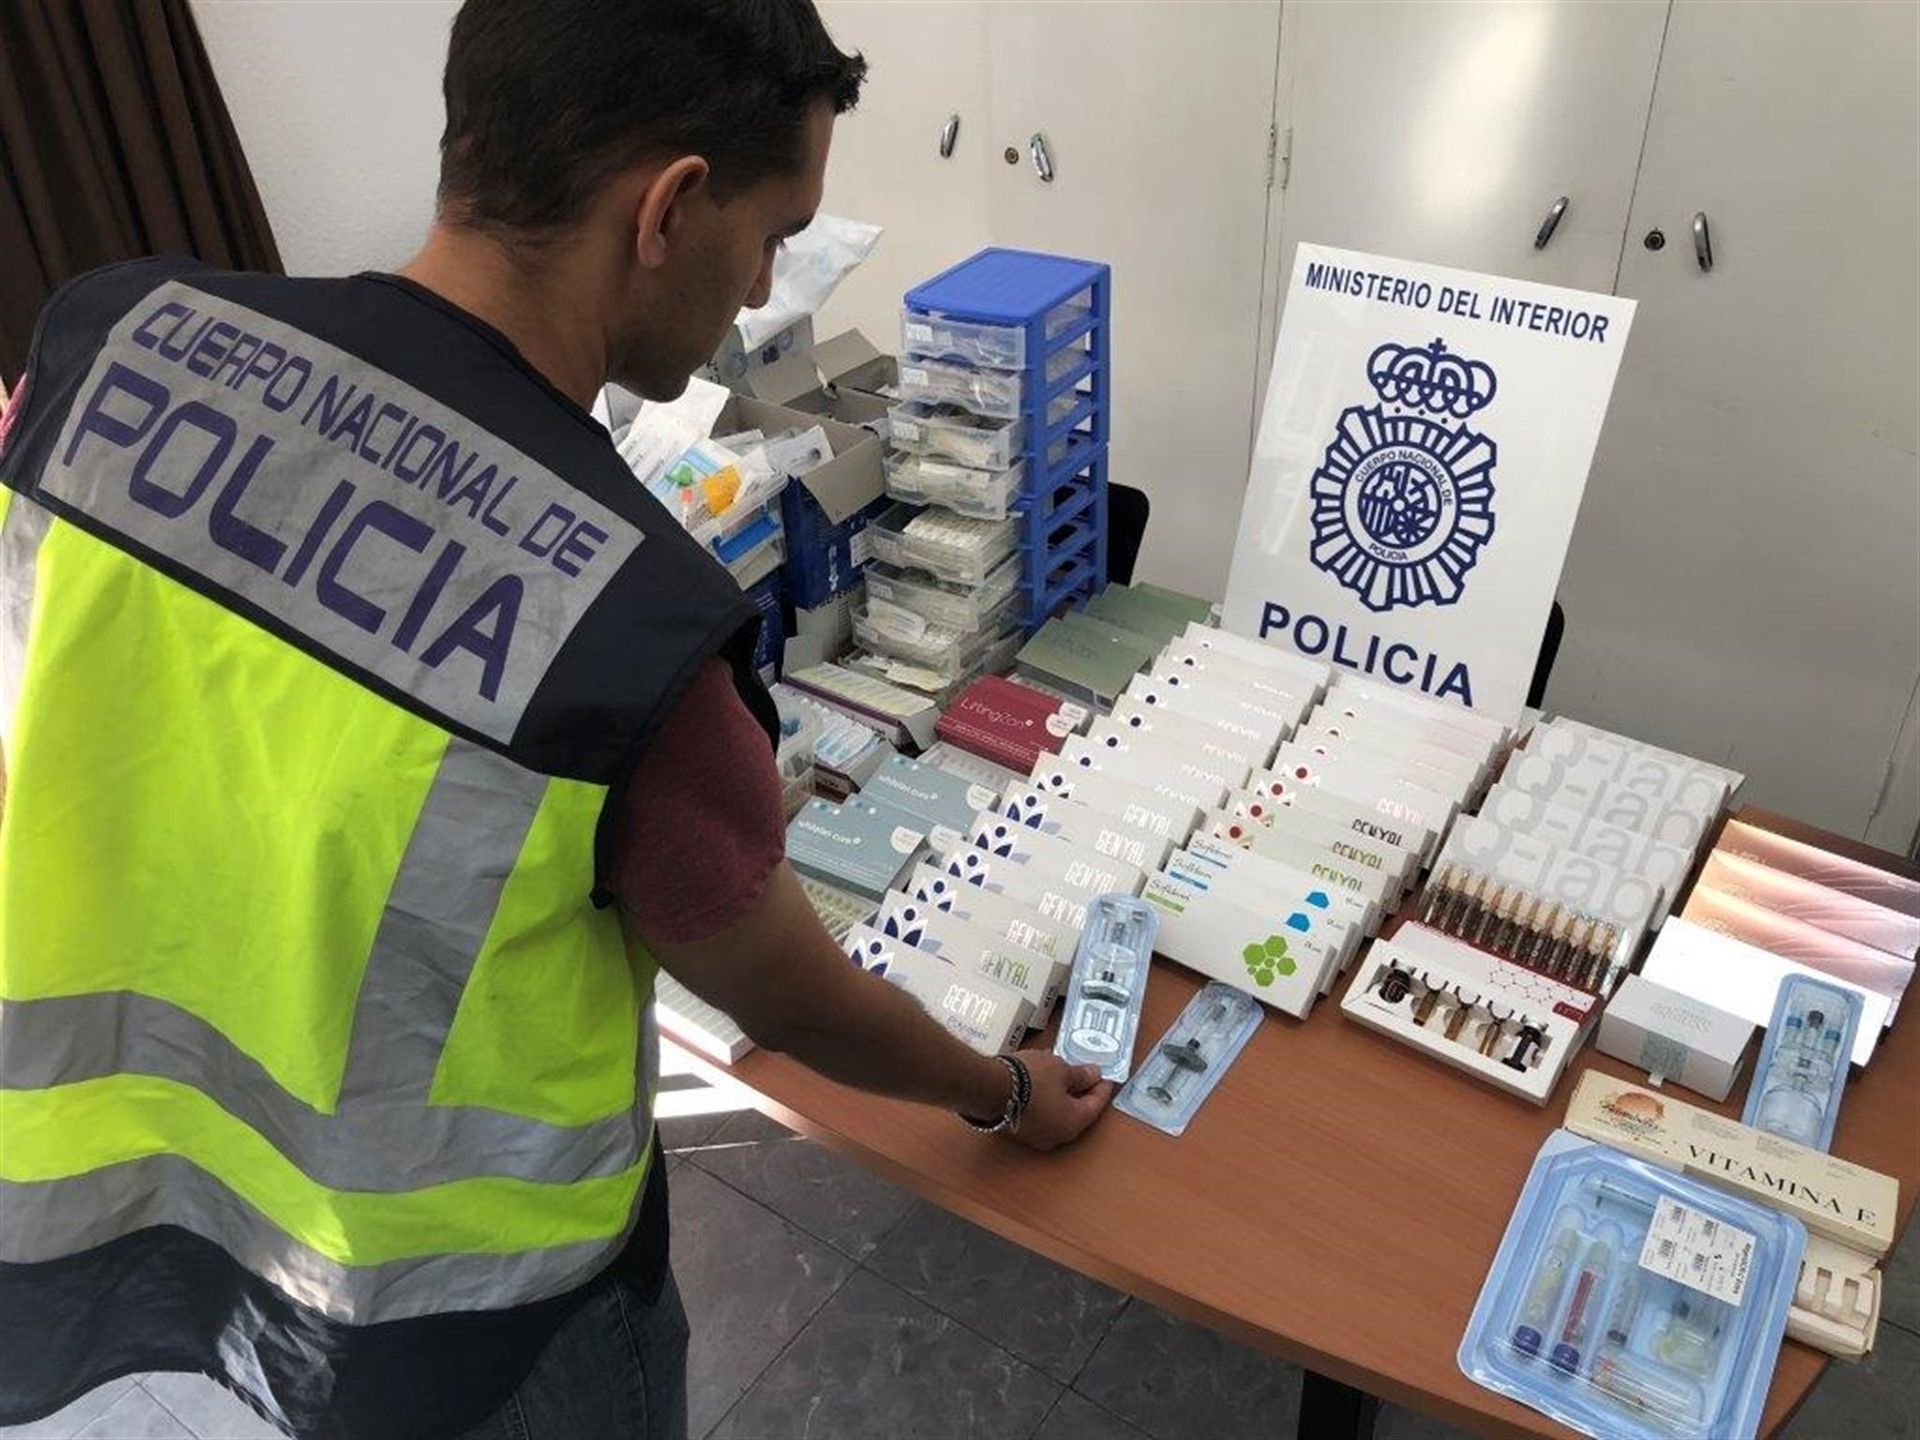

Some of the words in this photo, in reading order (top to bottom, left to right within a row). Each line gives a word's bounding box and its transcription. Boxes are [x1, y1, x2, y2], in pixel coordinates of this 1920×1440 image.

[1305, 262, 1432, 308] MINISTERIO
[1438, 286, 1481, 319] DEL
[1490, 296, 1610, 343] INTERIOR
[132, 302, 312, 413] CUERPO
[301, 374, 517, 537] NACIONAL
[517, 502, 608, 578] DE
[1355, 450, 1397, 483] CUERPO
[1399, 450, 1448, 490] NACIONAL
[1442, 486, 1454, 506] DE
[62, 361, 524, 703] POLICIA
[1368, 542, 1408, 562] POLICIA
[1258, 601, 1473, 708] POLICIA
[1095, 829, 1146, 866] GENYAL
[1006, 920, 1057, 958] GENYAL
[1038, 892, 1088, 930] GENYAL
[943, 984, 998, 1029] GENYAL
[1688, 1144, 1843, 1214] VITAMINA
[1856, 1207, 1878, 1228] E
